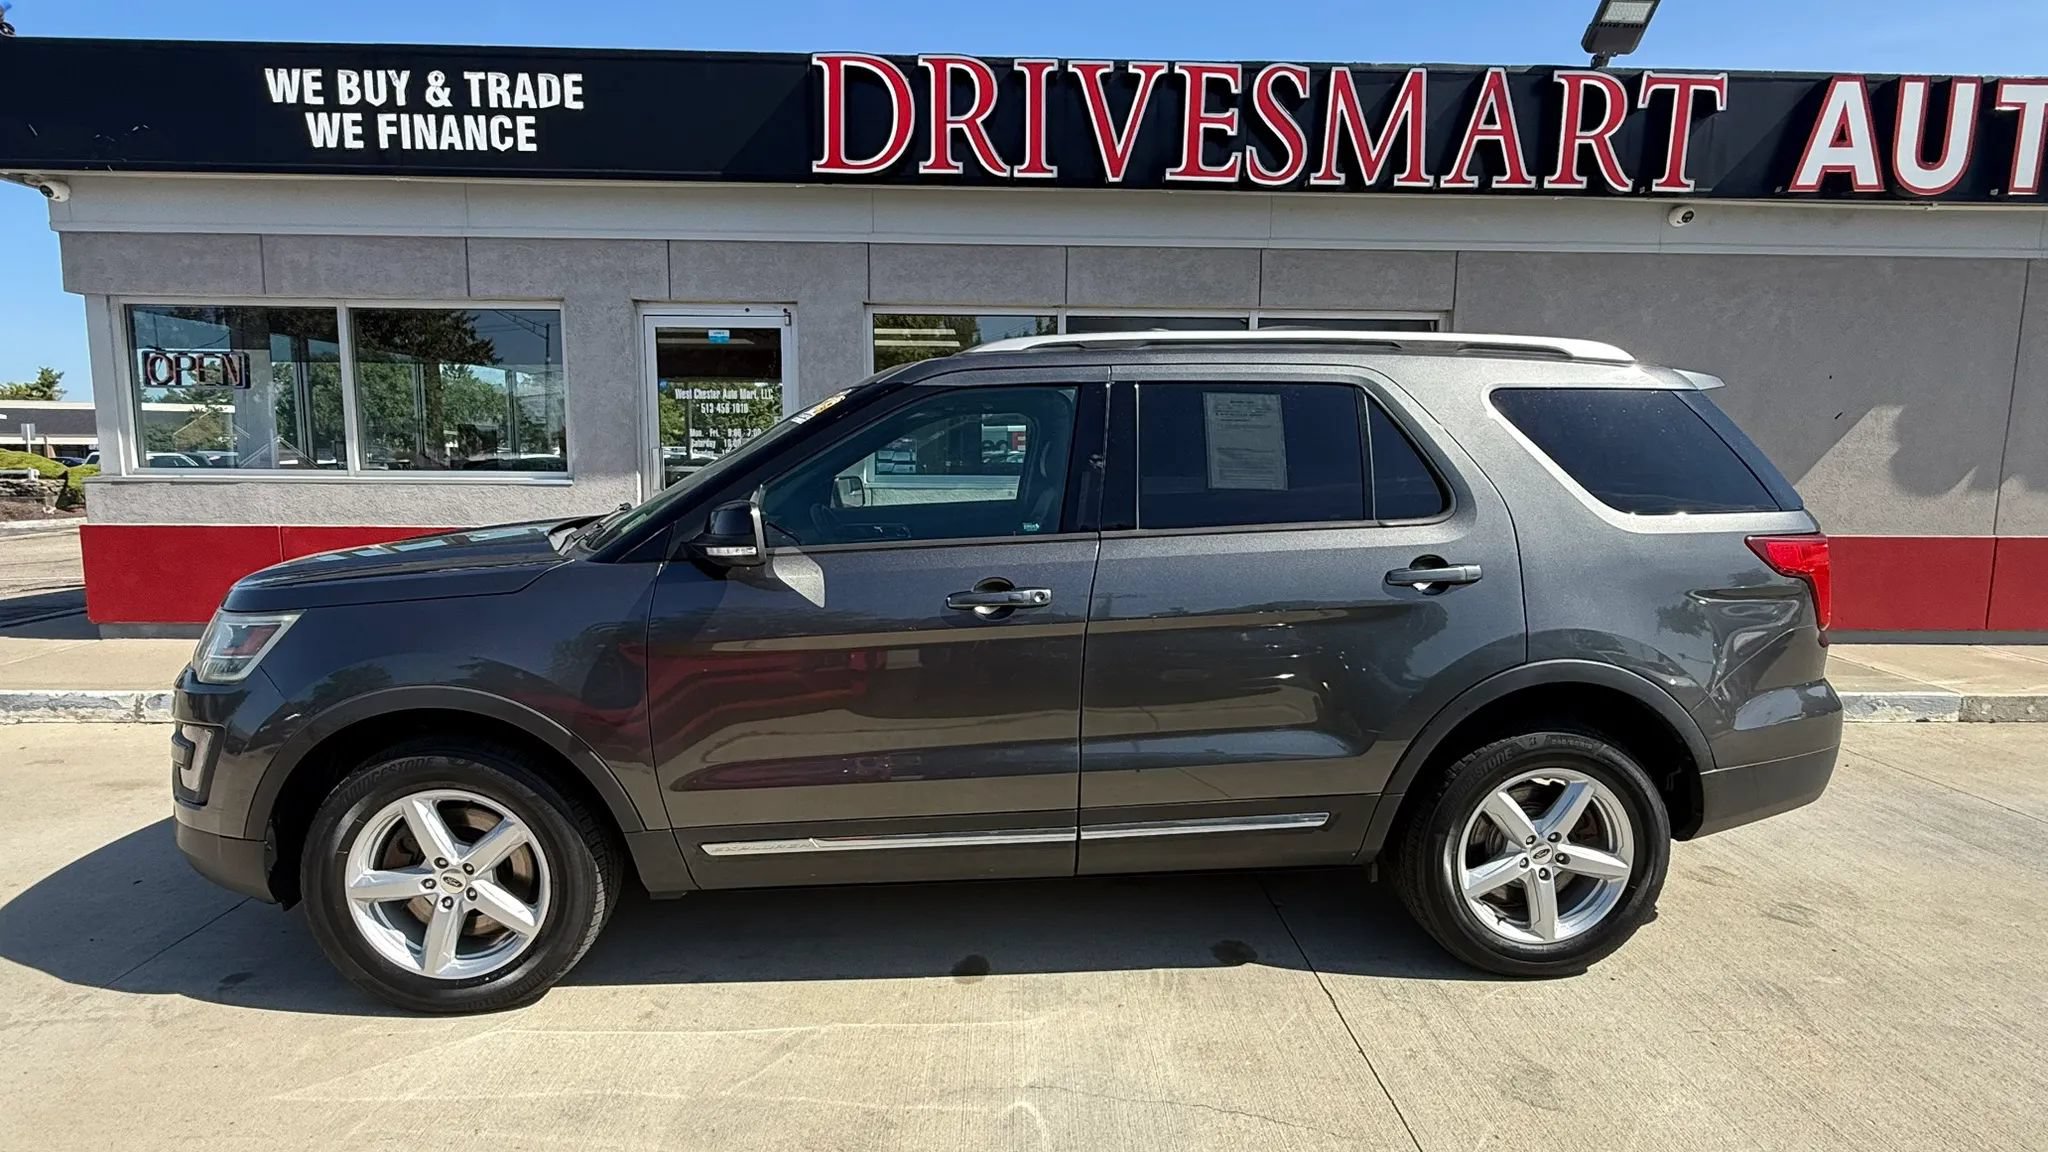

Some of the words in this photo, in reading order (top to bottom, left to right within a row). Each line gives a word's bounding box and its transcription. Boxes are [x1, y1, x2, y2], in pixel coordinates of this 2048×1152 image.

[264, 68, 324, 105] WE
[337, 69, 411, 107] BUY
[425, 70, 453, 108] &
[463, 71, 584, 110] TRADE
[305, 112, 364, 149] WE
[377, 113, 538, 152] FINANCE
[811, 52, 1728, 193] DRIVESMART
[1788, 75, 2048, 197] AUT
[146, 353, 246, 388] OPEN
[675, 388, 692, 400] West
[694, 388, 720, 400] Chester
[722, 388, 738, 400] Auto
